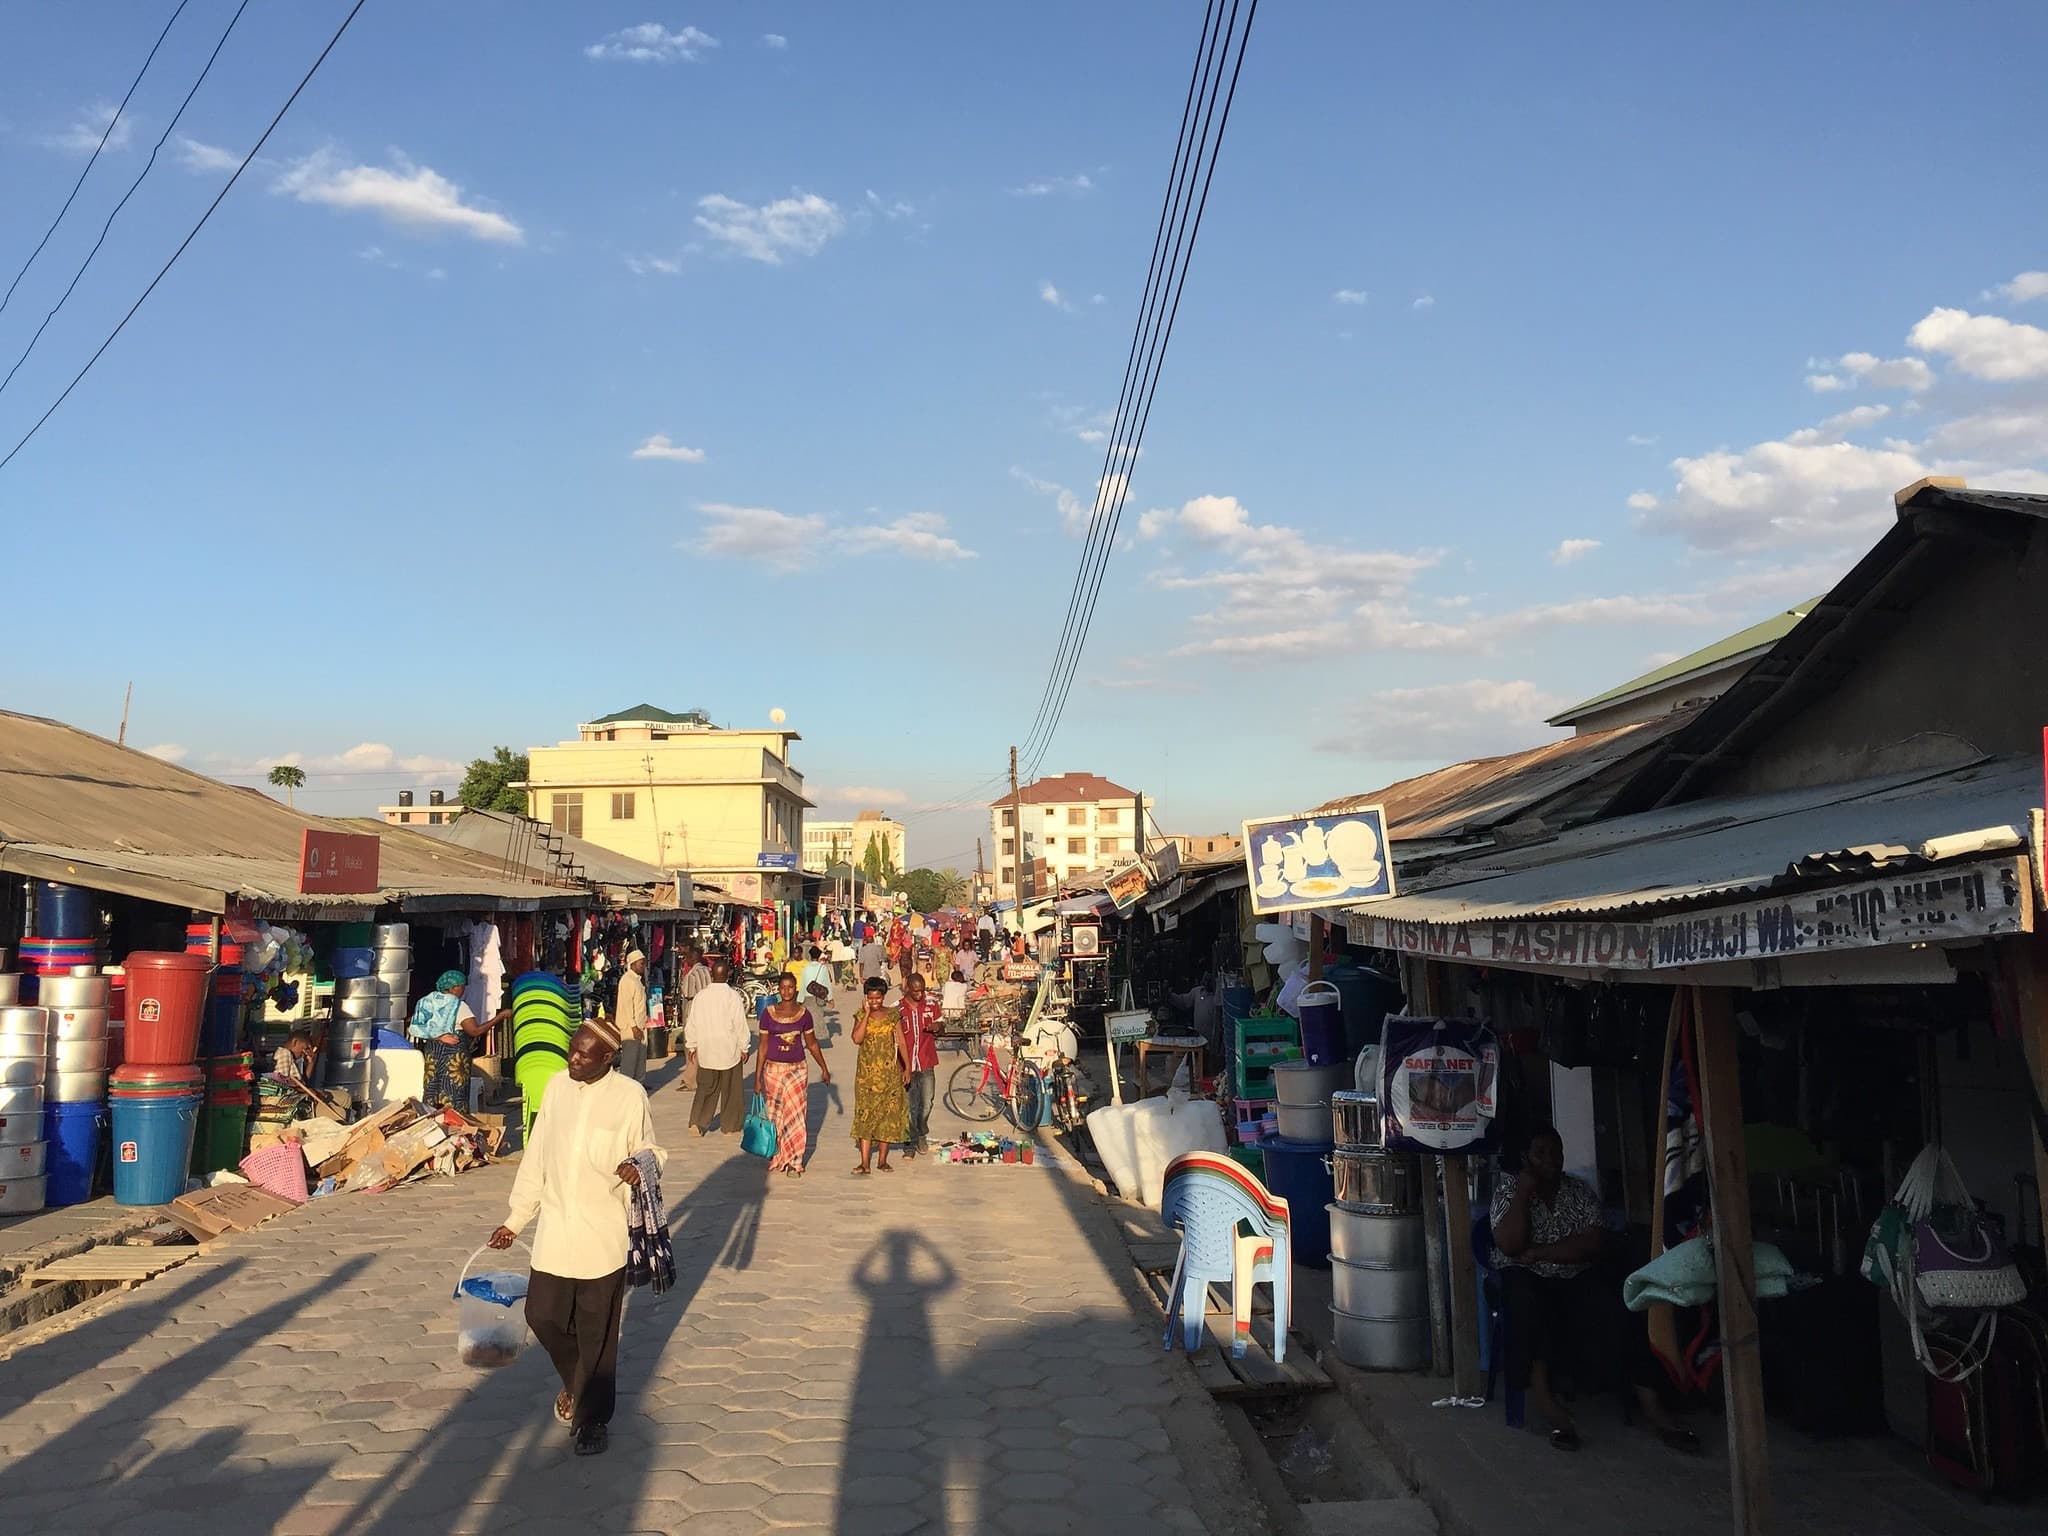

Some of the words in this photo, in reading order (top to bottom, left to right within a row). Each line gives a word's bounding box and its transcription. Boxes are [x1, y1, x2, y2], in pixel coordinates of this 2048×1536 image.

[292, 902, 322, 919] SHOP
[1386, 919, 1473, 957] KISIMA
[1492, 921, 1650, 968] FASHION
[1007, 963, 1040, 971] WAKALA
[1446, 1058, 1474, 1070] NET
